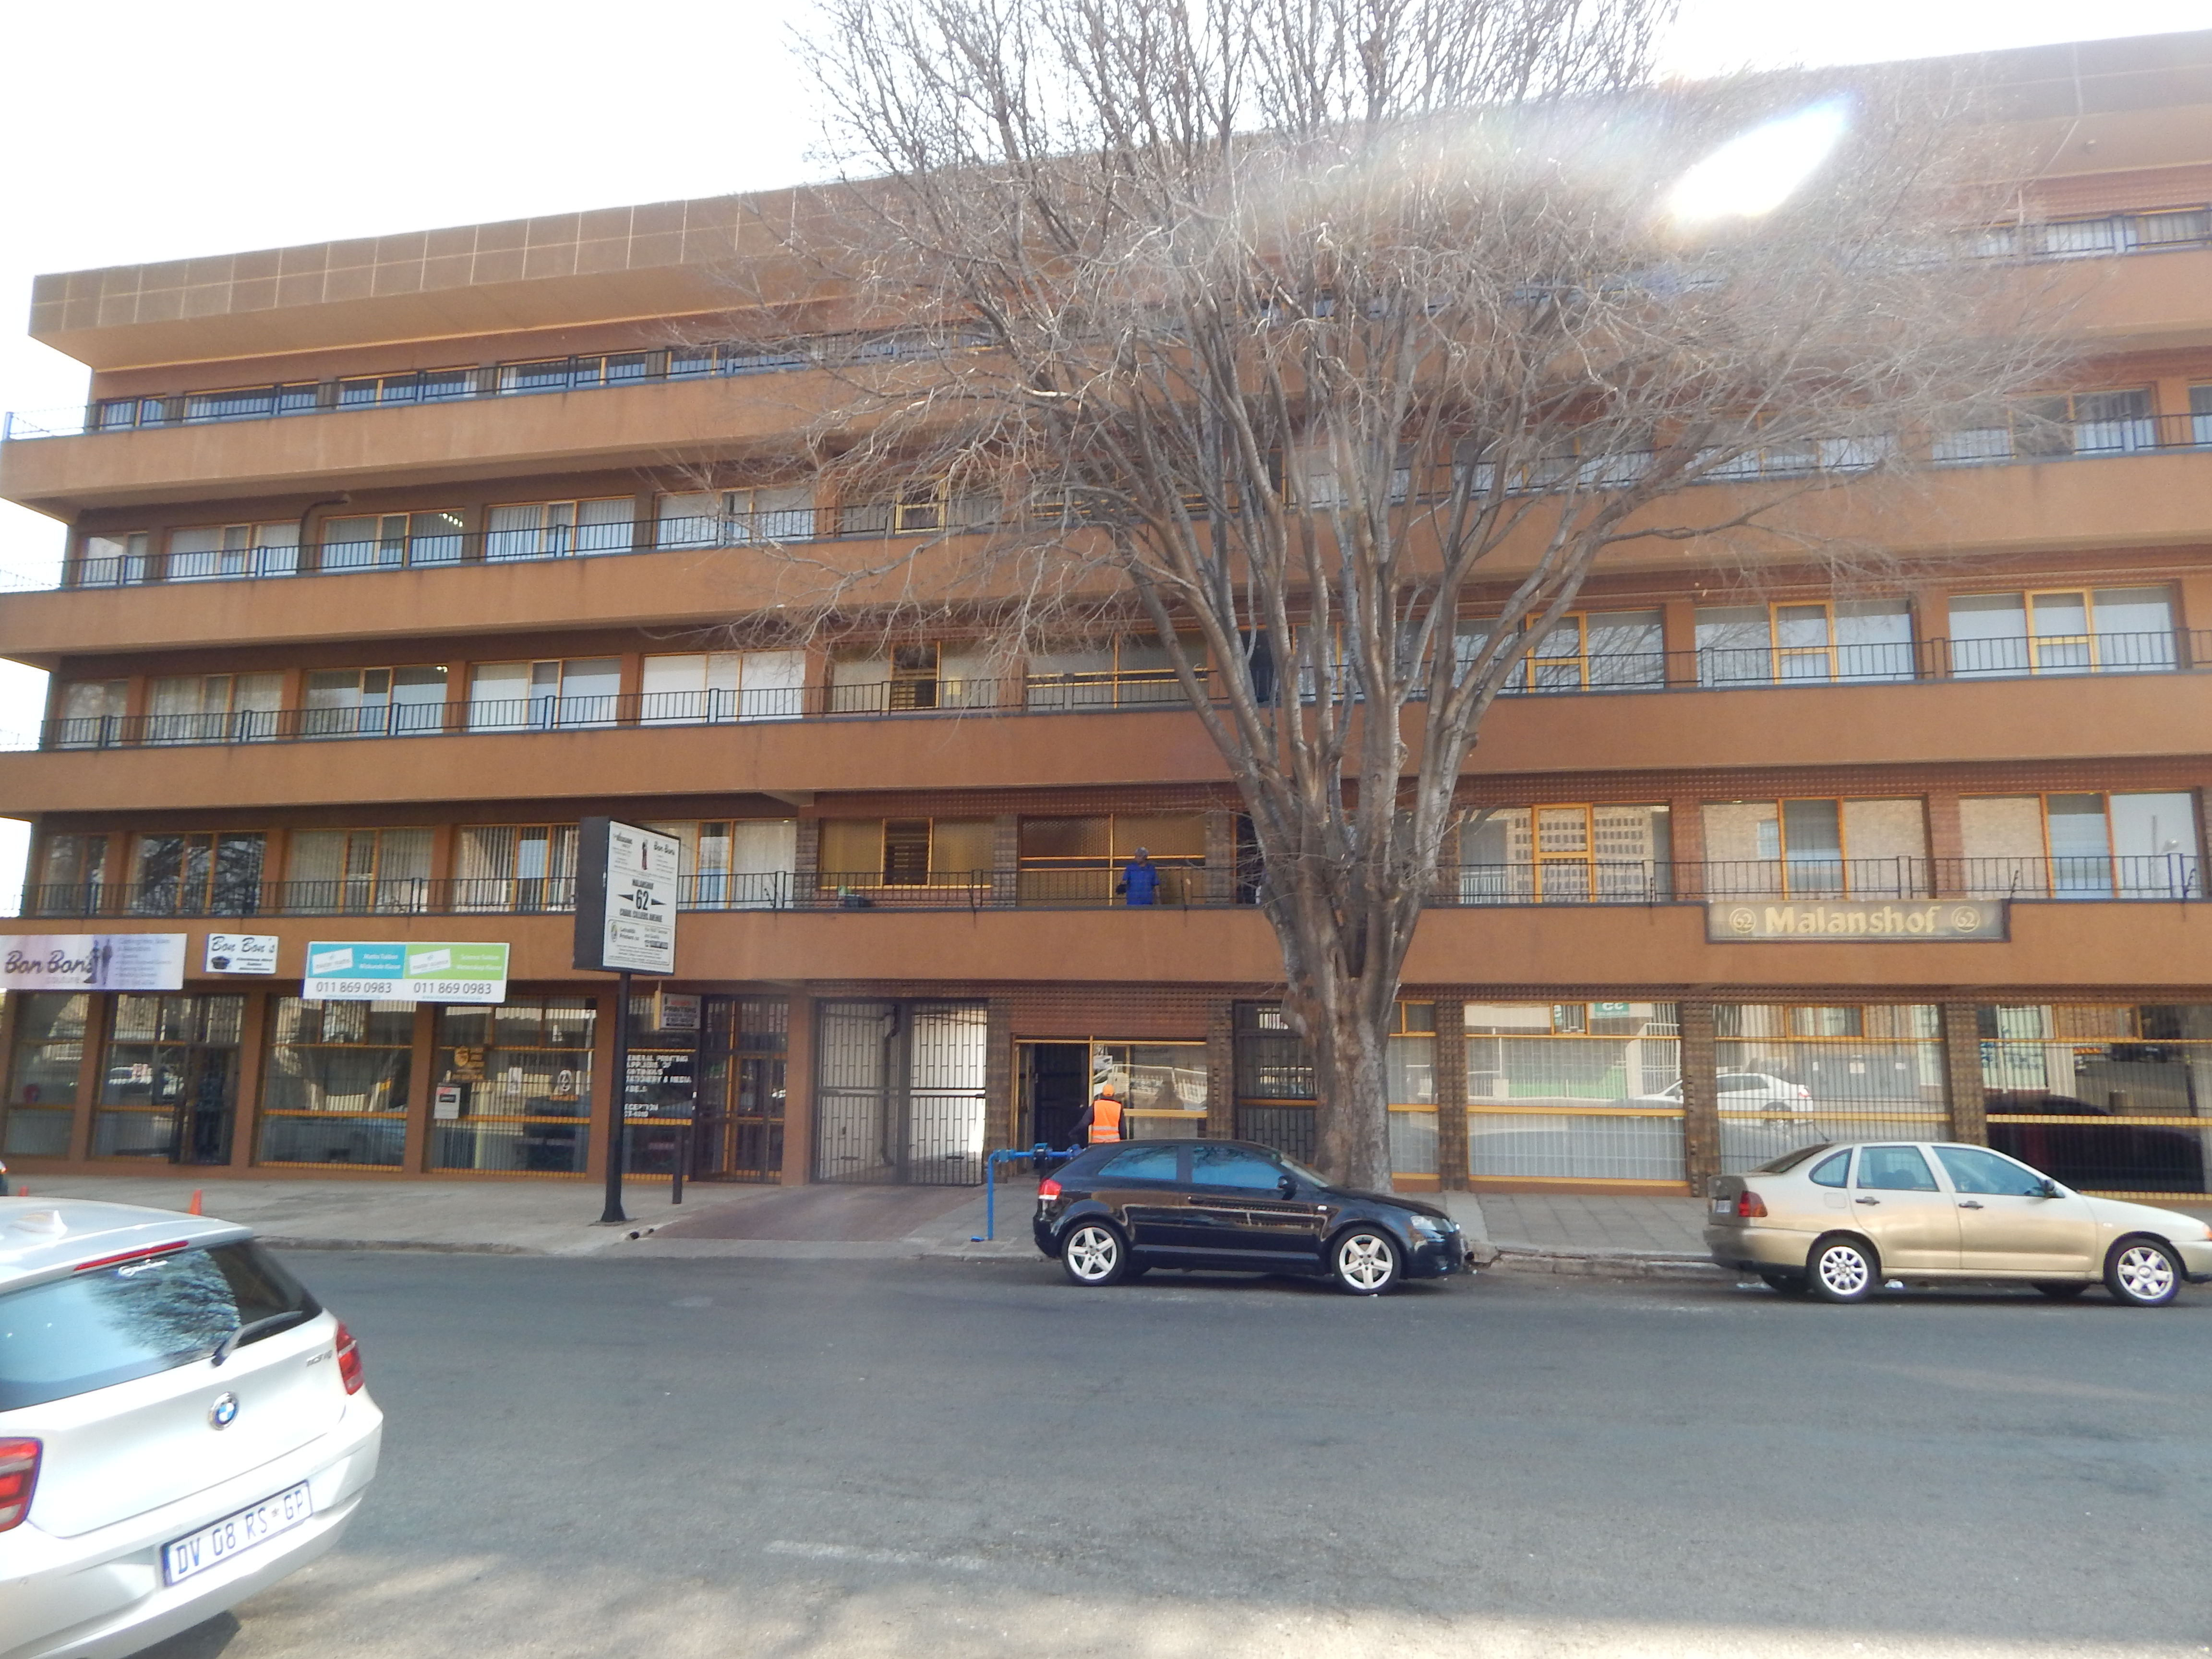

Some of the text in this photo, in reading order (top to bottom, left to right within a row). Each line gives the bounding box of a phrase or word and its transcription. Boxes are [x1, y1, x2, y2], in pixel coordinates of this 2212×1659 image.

[636, 889, 649, 910] 62
[1733, 905, 1975, 933] 62 Malanshof 62
[211, 936, 235, 951] Bon
[5, 950, 42, 974] Bon
[316, 982, 392, 993] 011 869 0983
[413, 982, 492, 994] 011 869 0983
[176, 1489, 303, 1574] DV 08 RS GP
